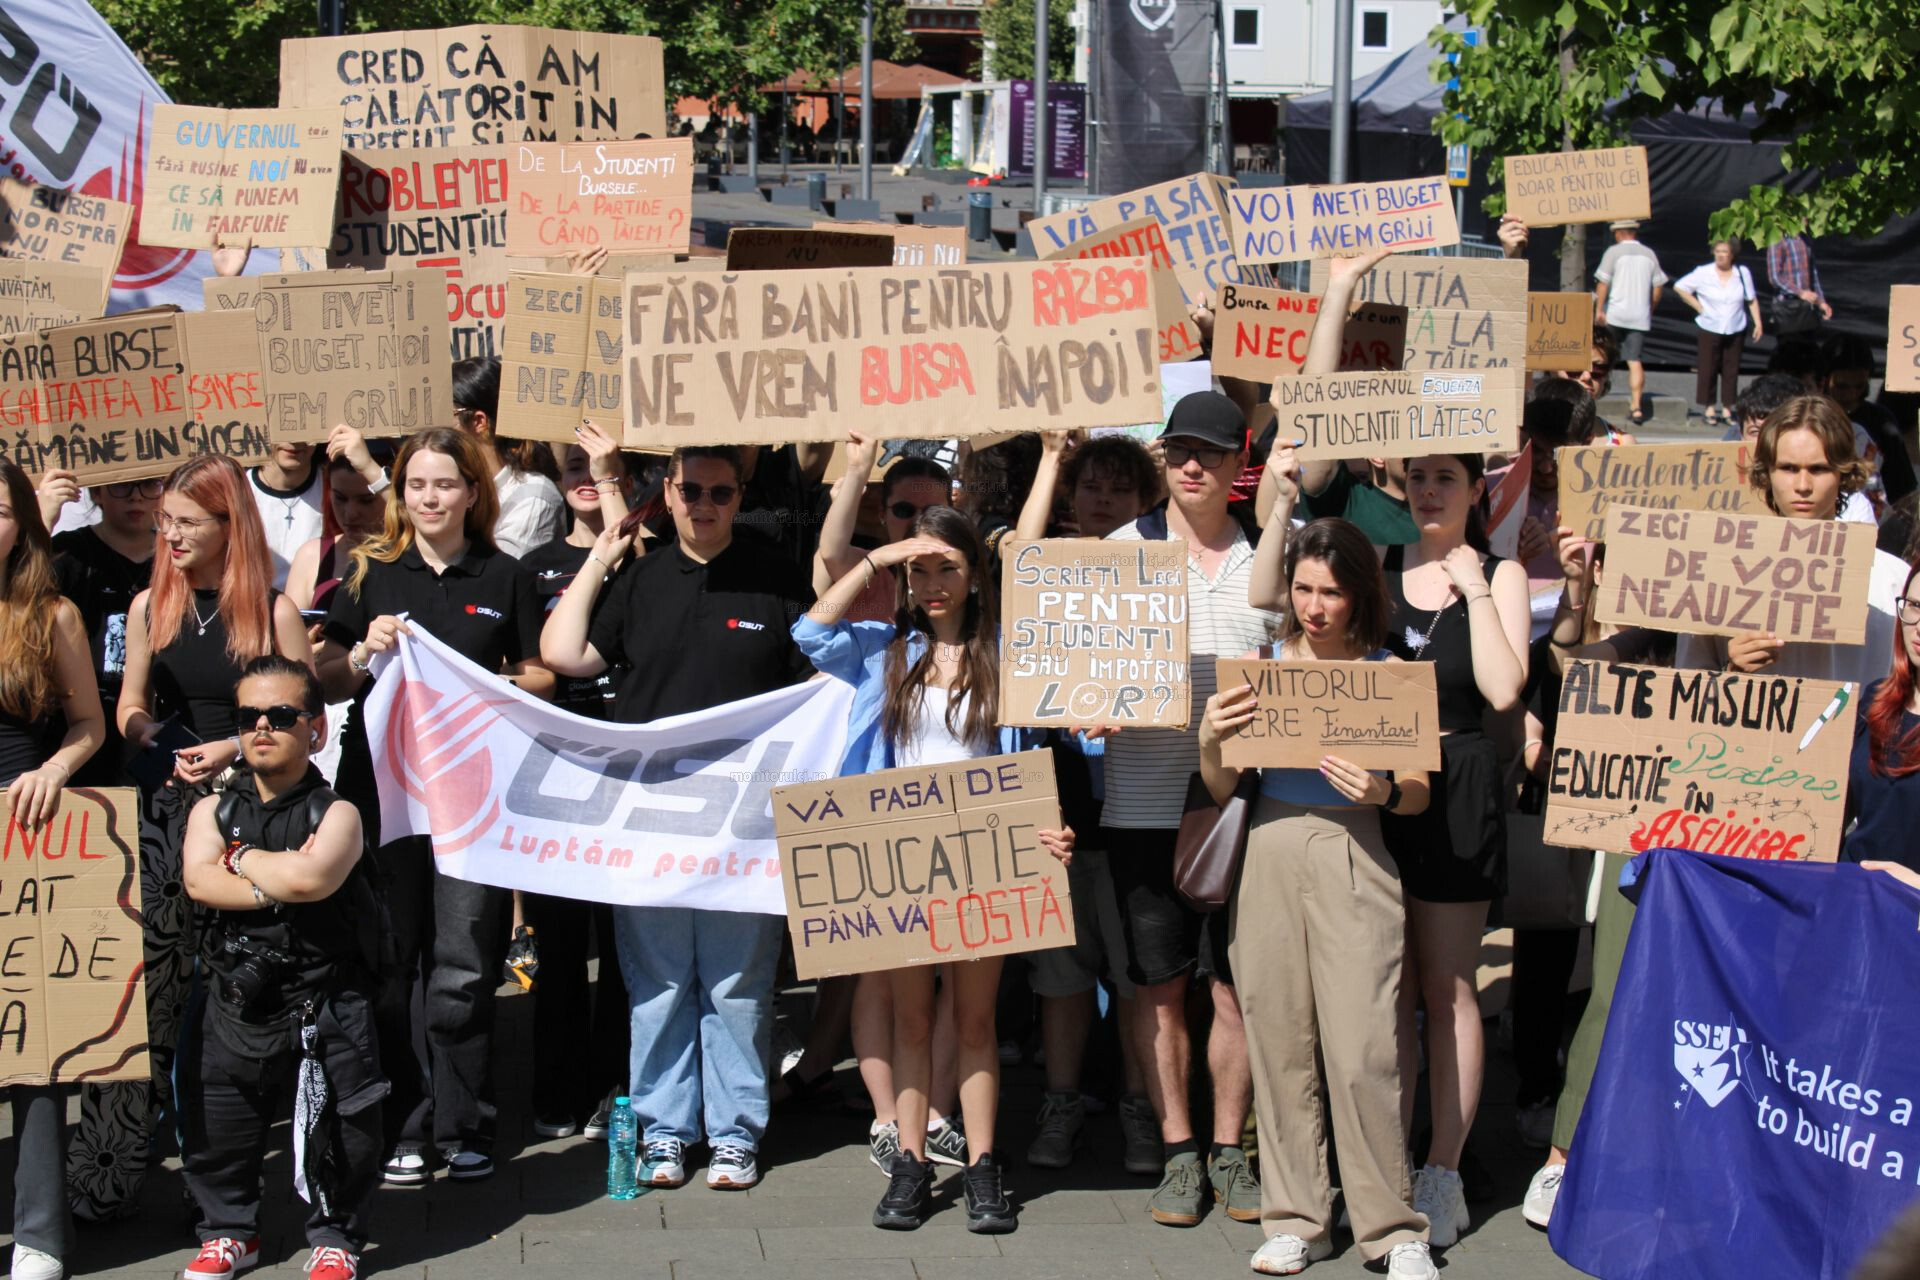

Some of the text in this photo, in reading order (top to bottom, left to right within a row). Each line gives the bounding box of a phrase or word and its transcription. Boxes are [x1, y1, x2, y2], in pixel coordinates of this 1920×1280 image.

[336, 34, 600, 91] CRED CĂ AM
[574, 88, 618, 131] ÎN
[176, 121, 300, 149] GUVERNUL
[248, 156, 290, 182] NOI
[294, 158, 308, 174] NU
[1594, 151, 1616, 168] NU
[1624, 149, 1634, 165] E
[169, 184, 299, 206] CE SĂ PUNEM
[1232, 188, 1295, 225] VOI
[1313, 188, 1370, 217] AVEȚI
[1376, 182, 1442, 212] BUGET
[1517, 168, 1641, 197] DOAR PENTRU CEI
[30, 186, 107, 222] BURSA
[172, 207, 289, 233] ÎN FARFURIE
[1044, 207, 1098, 249] VĂ
[1118, 176, 1213, 226] PASĂ
[1538, 197, 1560, 216] CU
[4, 208, 116, 245] NOASTRĂ
[9, 232, 49, 254] NU
[61, 243, 86, 263] E
[1245, 215, 1433, 257] NOI AVEM GRIJI
[525, 286, 583, 314] ZECI
[629, 273, 739, 346] FĂRĂ
[761, 271, 862, 344] BANI
[880, 270, 1012, 334] PENTRU
[1031, 258, 1148, 327] RĂZBOI
[1540, 303, 1567, 325] NU
[377, 325, 431, 371] NOI
[530, 331, 556, 354] DE
[1451, 310, 1494, 352] LA
[2, 325, 185, 382] ĂRĂ BURSE,
[0, 377, 143, 428] GALITATEA
[151, 374, 184, 414] DE
[343, 376, 434, 429] GRIJI
[517, 365, 622, 410] NEAU
[629, 353, 695, 428] NE
[860, 345, 976, 405] BURSA
[1282, 378, 1325, 405] DACĂ
[1328, 378, 1416, 401] GUVERNUL
[135, 425, 182, 461] UN
[1407, 405, 1498, 441] PLĂTESC
[1569, 449, 1731, 492] Studenții
[1704, 489, 1750, 512] cu
[1618, 511, 1691, 541] ZECI
[1714, 517, 1758, 550] DE
[1779, 519, 1849, 557] MII
[1665, 547, 1847, 593] DE VOCI
[1037, 591, 1185, 624] PENTRU
[1615, 573, 1843, 641] NEAUZITE
[1013, 653, 1069, 678] SAU
[1242, 663, 1393, 701] VIITORUL
[1034, 681, 1173, 722] LOR?
[1558, 659, 1803, 733] ALTE MĂSURI
[787, 763, 1023, 822] VĂ PASĂ DE
[1683, 782, 1714, 814] ÎN
[3, 810, 108, 862] NUL
[500, 825, 781, 879] Luptăm pentru
[804, 876, 1066, 953] PÂNĂ VĂ COSTĂ
[49, 934, 121, 980] DE
[1761, 1044, 1913, 1126] It takes a
[1758, 1096, 1904, 1179] to build a
